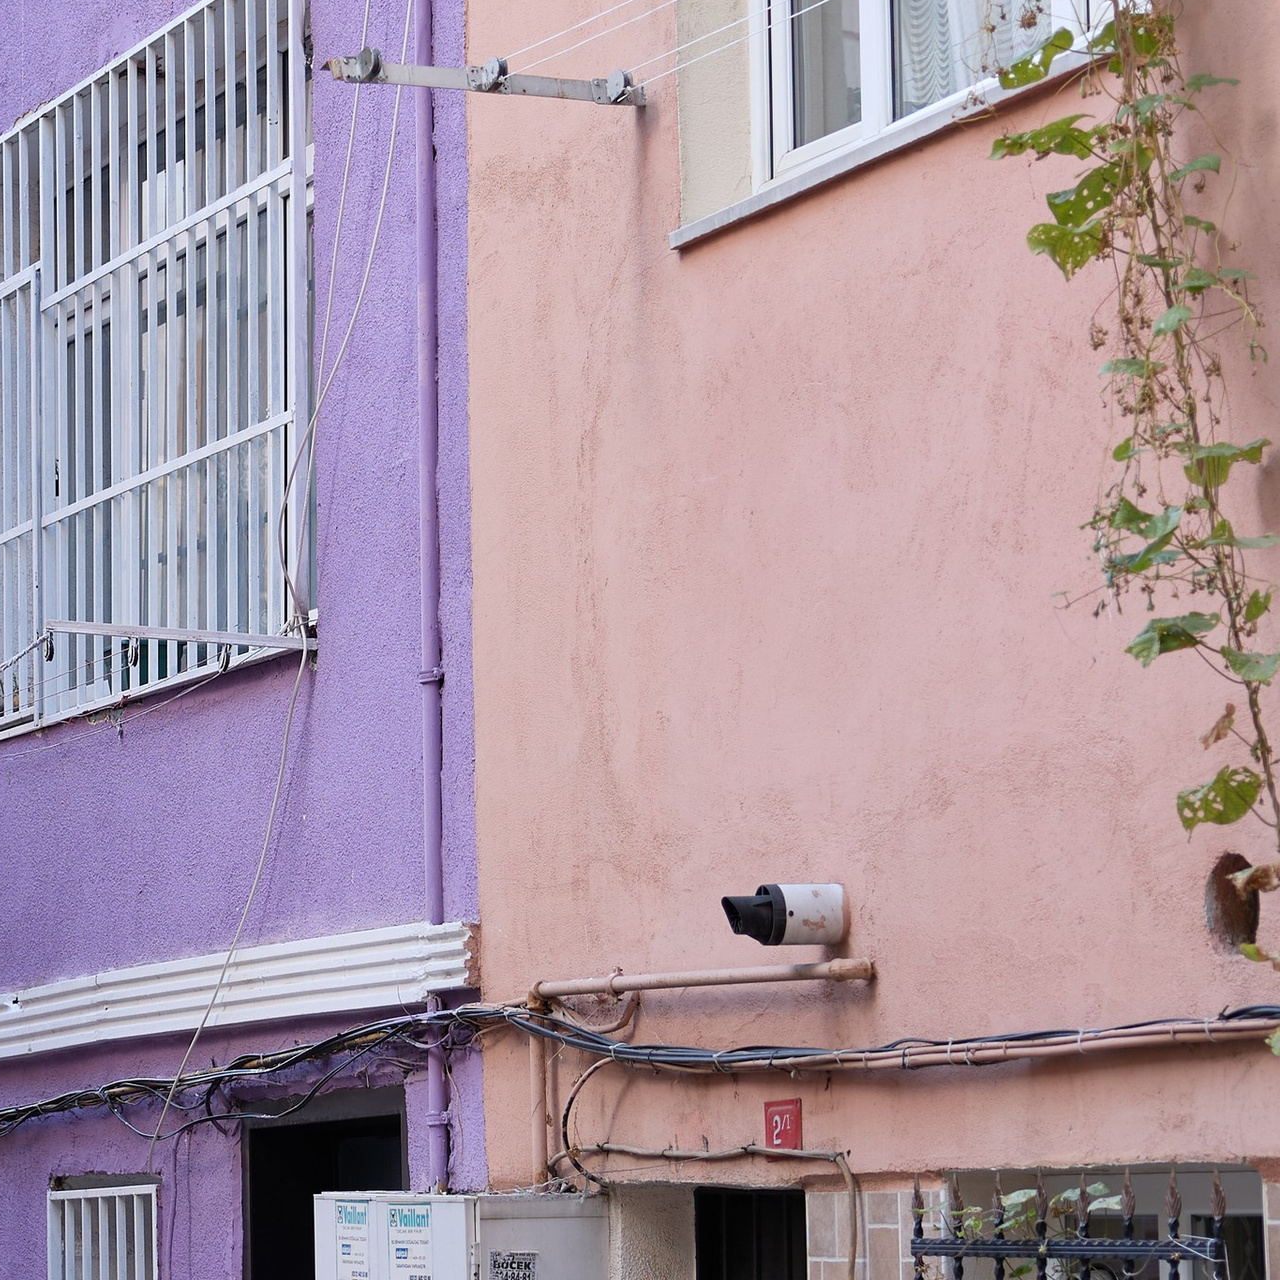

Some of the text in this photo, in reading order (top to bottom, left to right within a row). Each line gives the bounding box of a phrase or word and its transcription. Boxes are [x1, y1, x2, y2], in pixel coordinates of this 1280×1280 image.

[773, 1114, 791, 1145] 2/1
[343, 1205, 367, 1225] Vaillant
[397, 1208, 429, 1227] Vaillant
